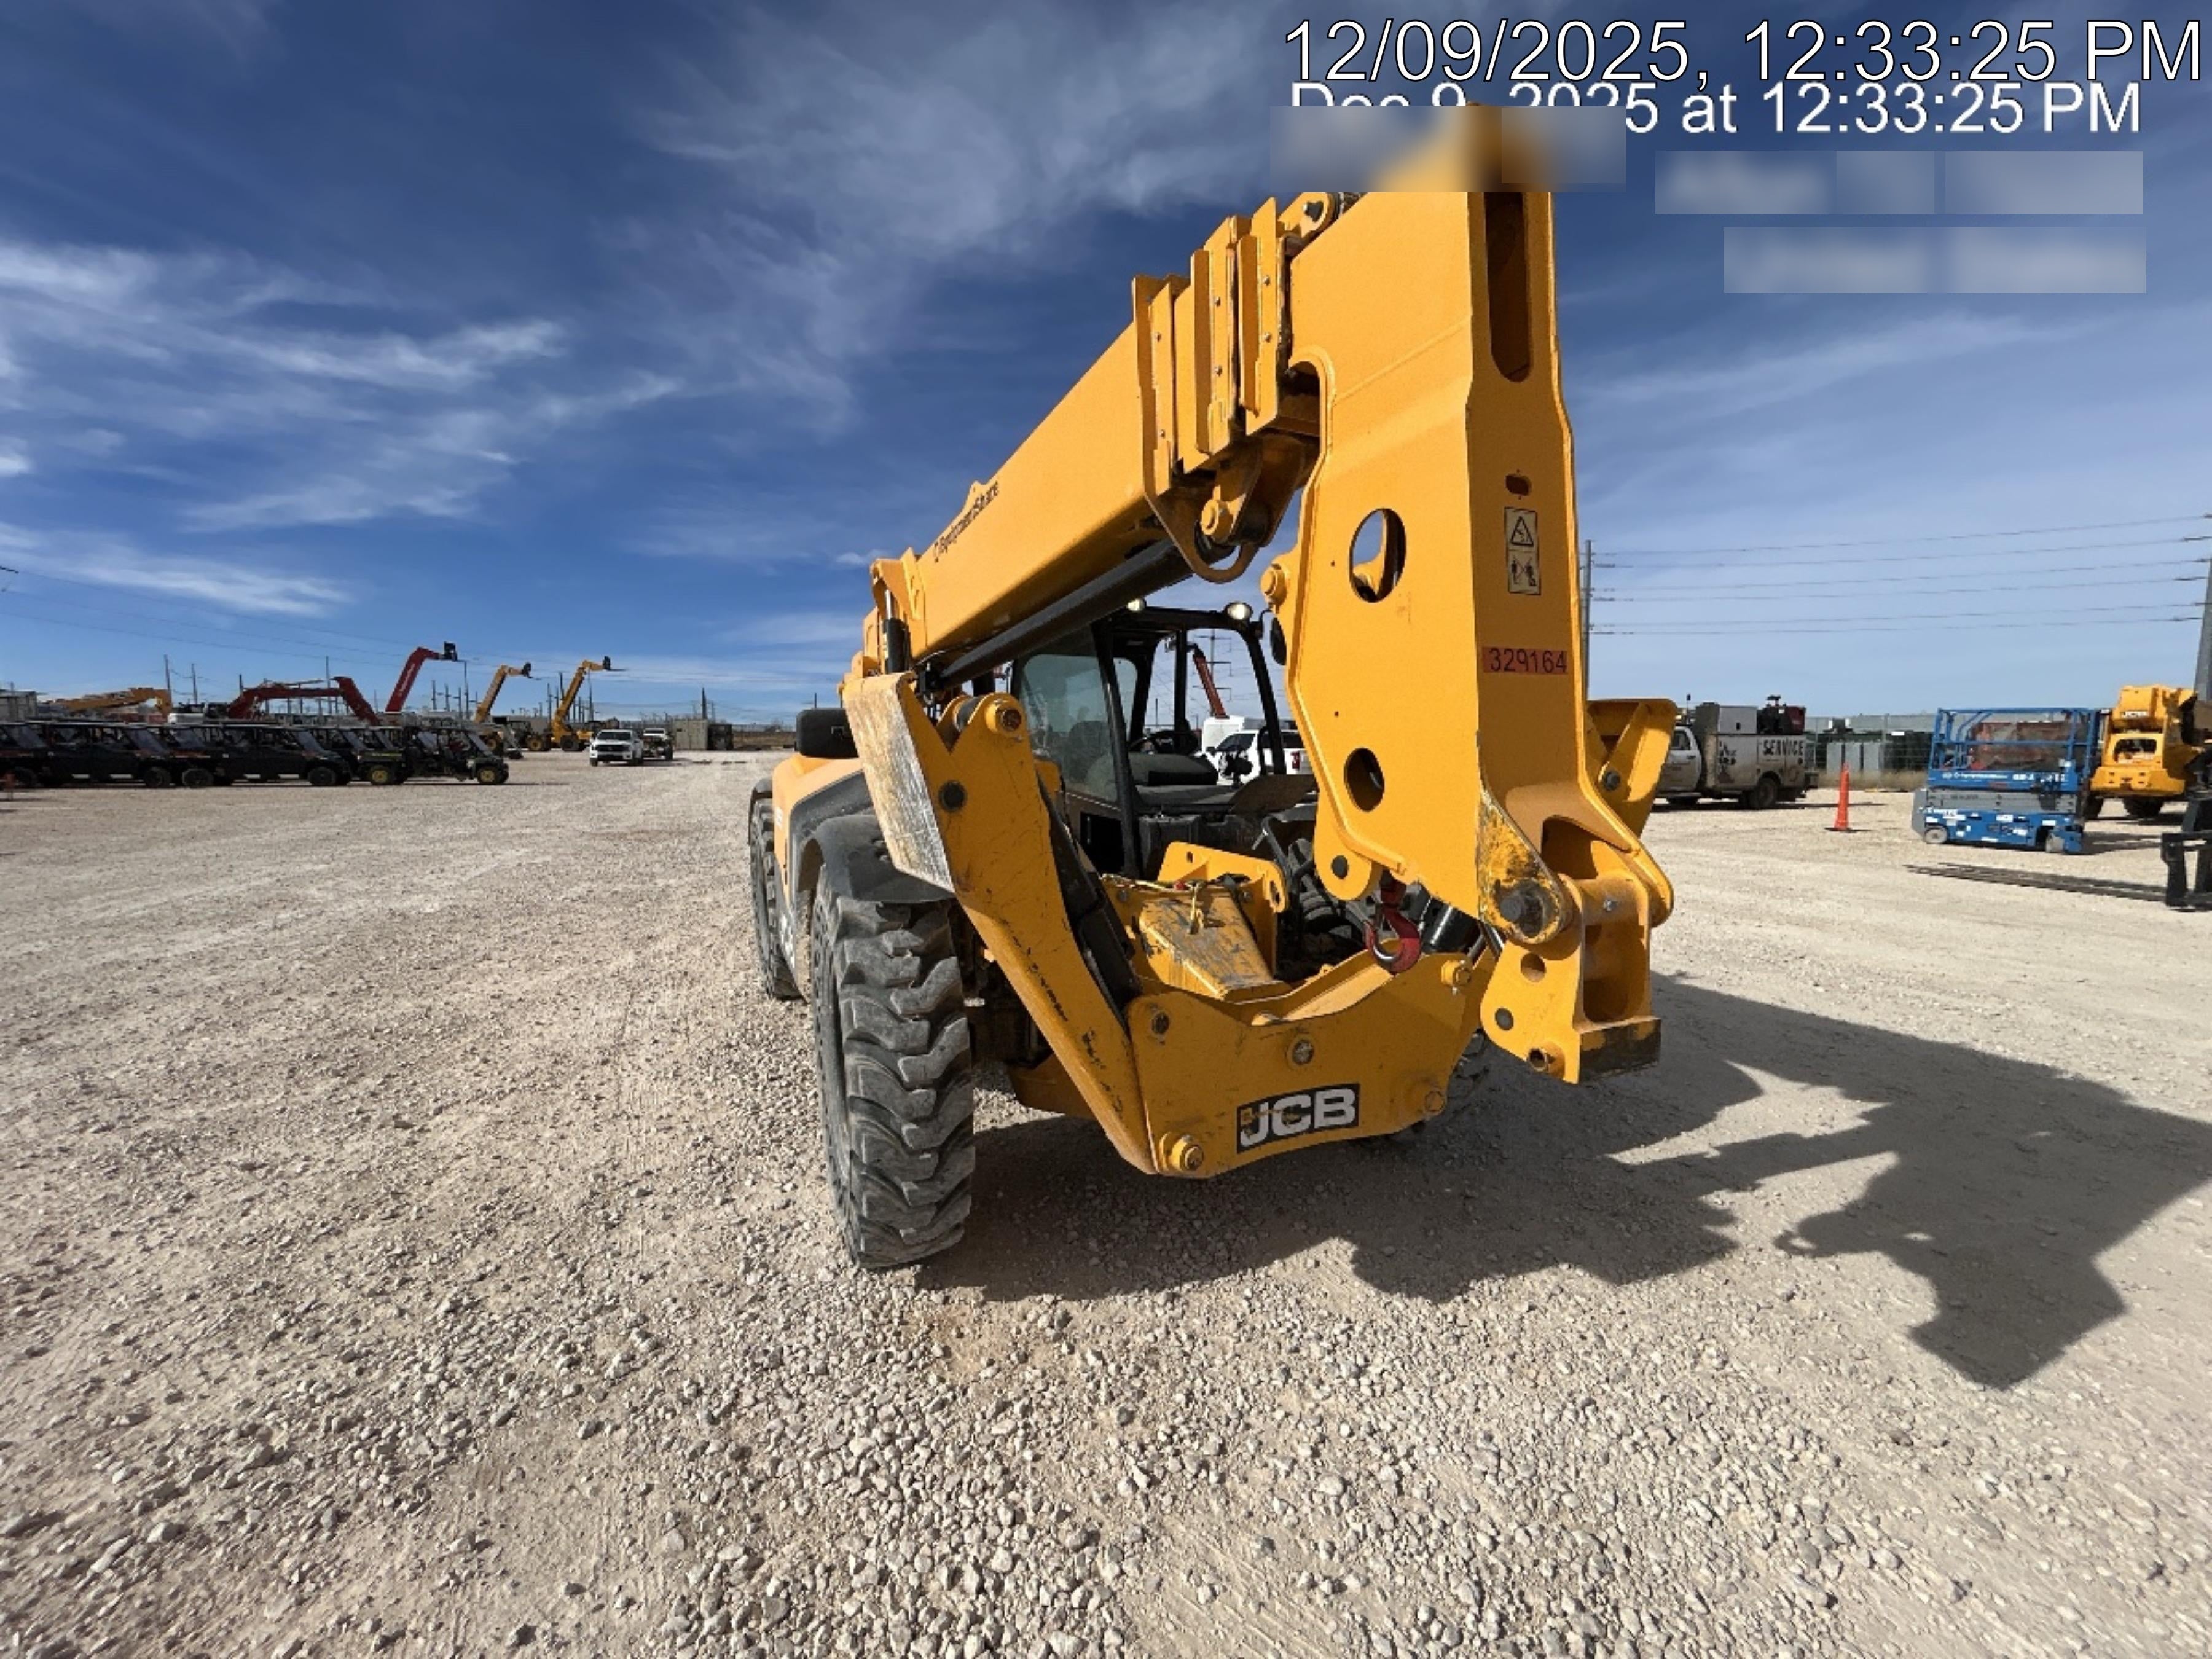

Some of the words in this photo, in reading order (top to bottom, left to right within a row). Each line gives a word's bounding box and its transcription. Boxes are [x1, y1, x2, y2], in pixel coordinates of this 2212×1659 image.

[1489, 647, 1567, 674] 329164
[1763, 739, 1804, 756] SERVICE
[1240, 1088, 1355, 1147] JCB
